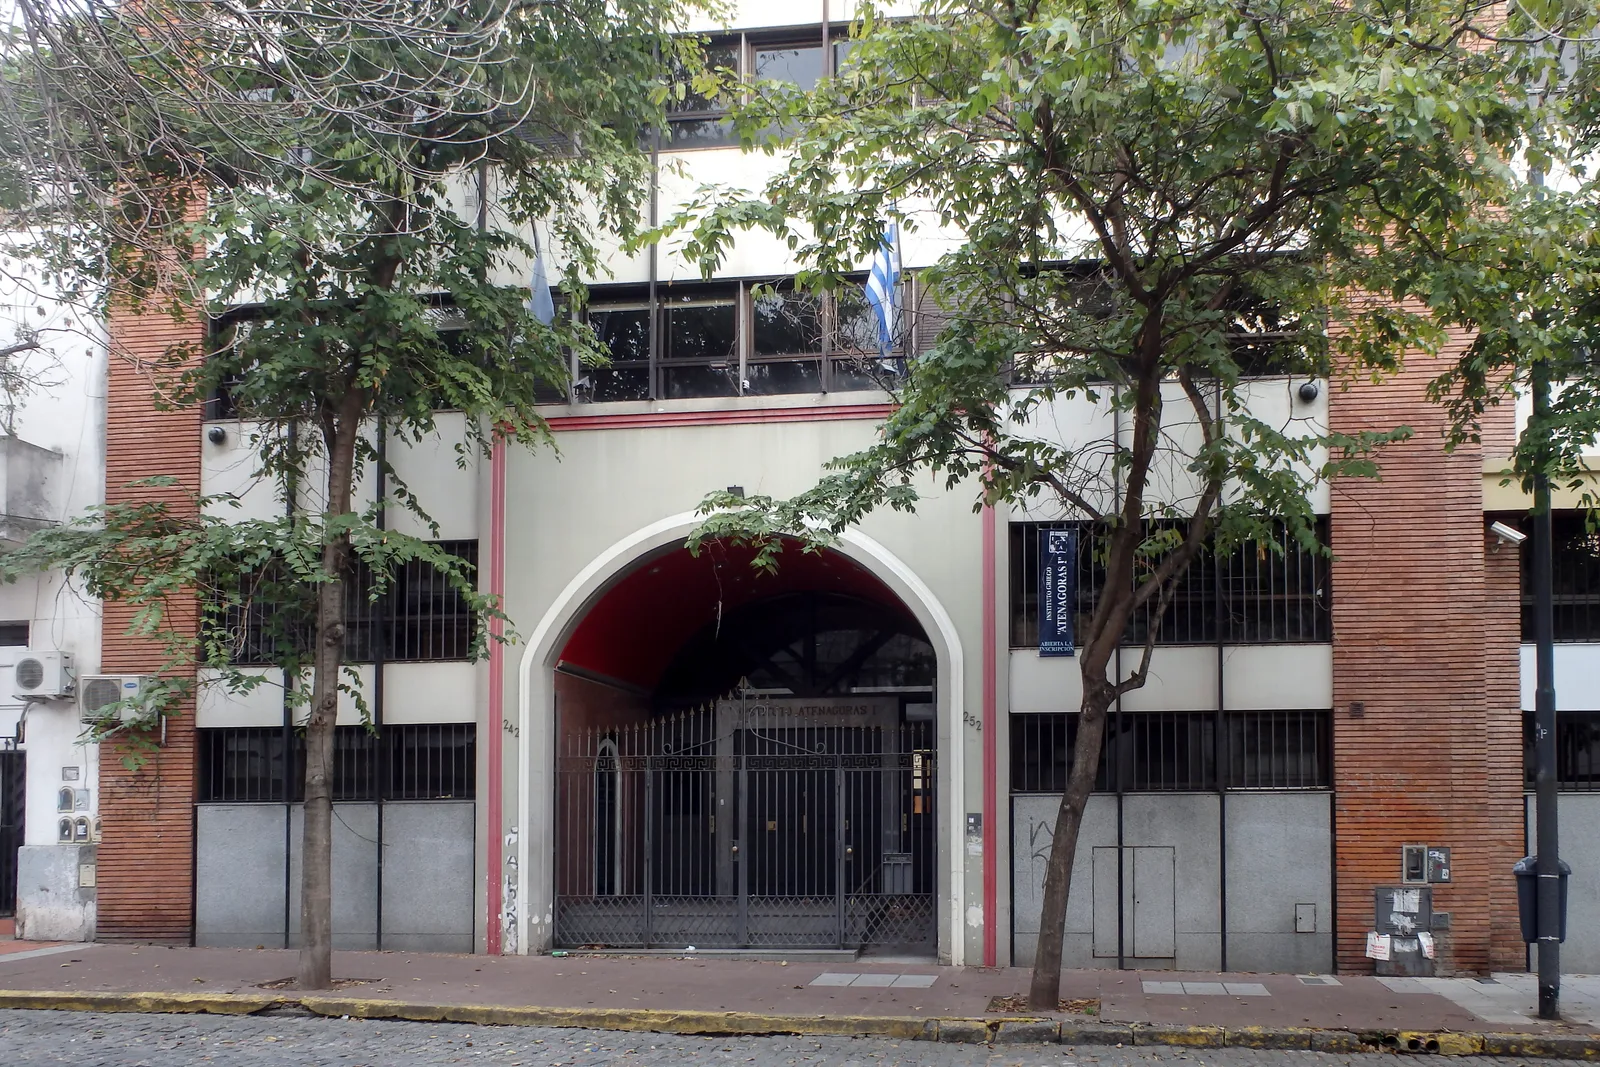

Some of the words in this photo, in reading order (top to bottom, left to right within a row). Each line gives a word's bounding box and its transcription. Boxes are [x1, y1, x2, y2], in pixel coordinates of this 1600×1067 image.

[798, 705, 868, 715] ATENAGORAS
[503, 719, 519, 738] 242
[963, 711, 982, 731] 252
